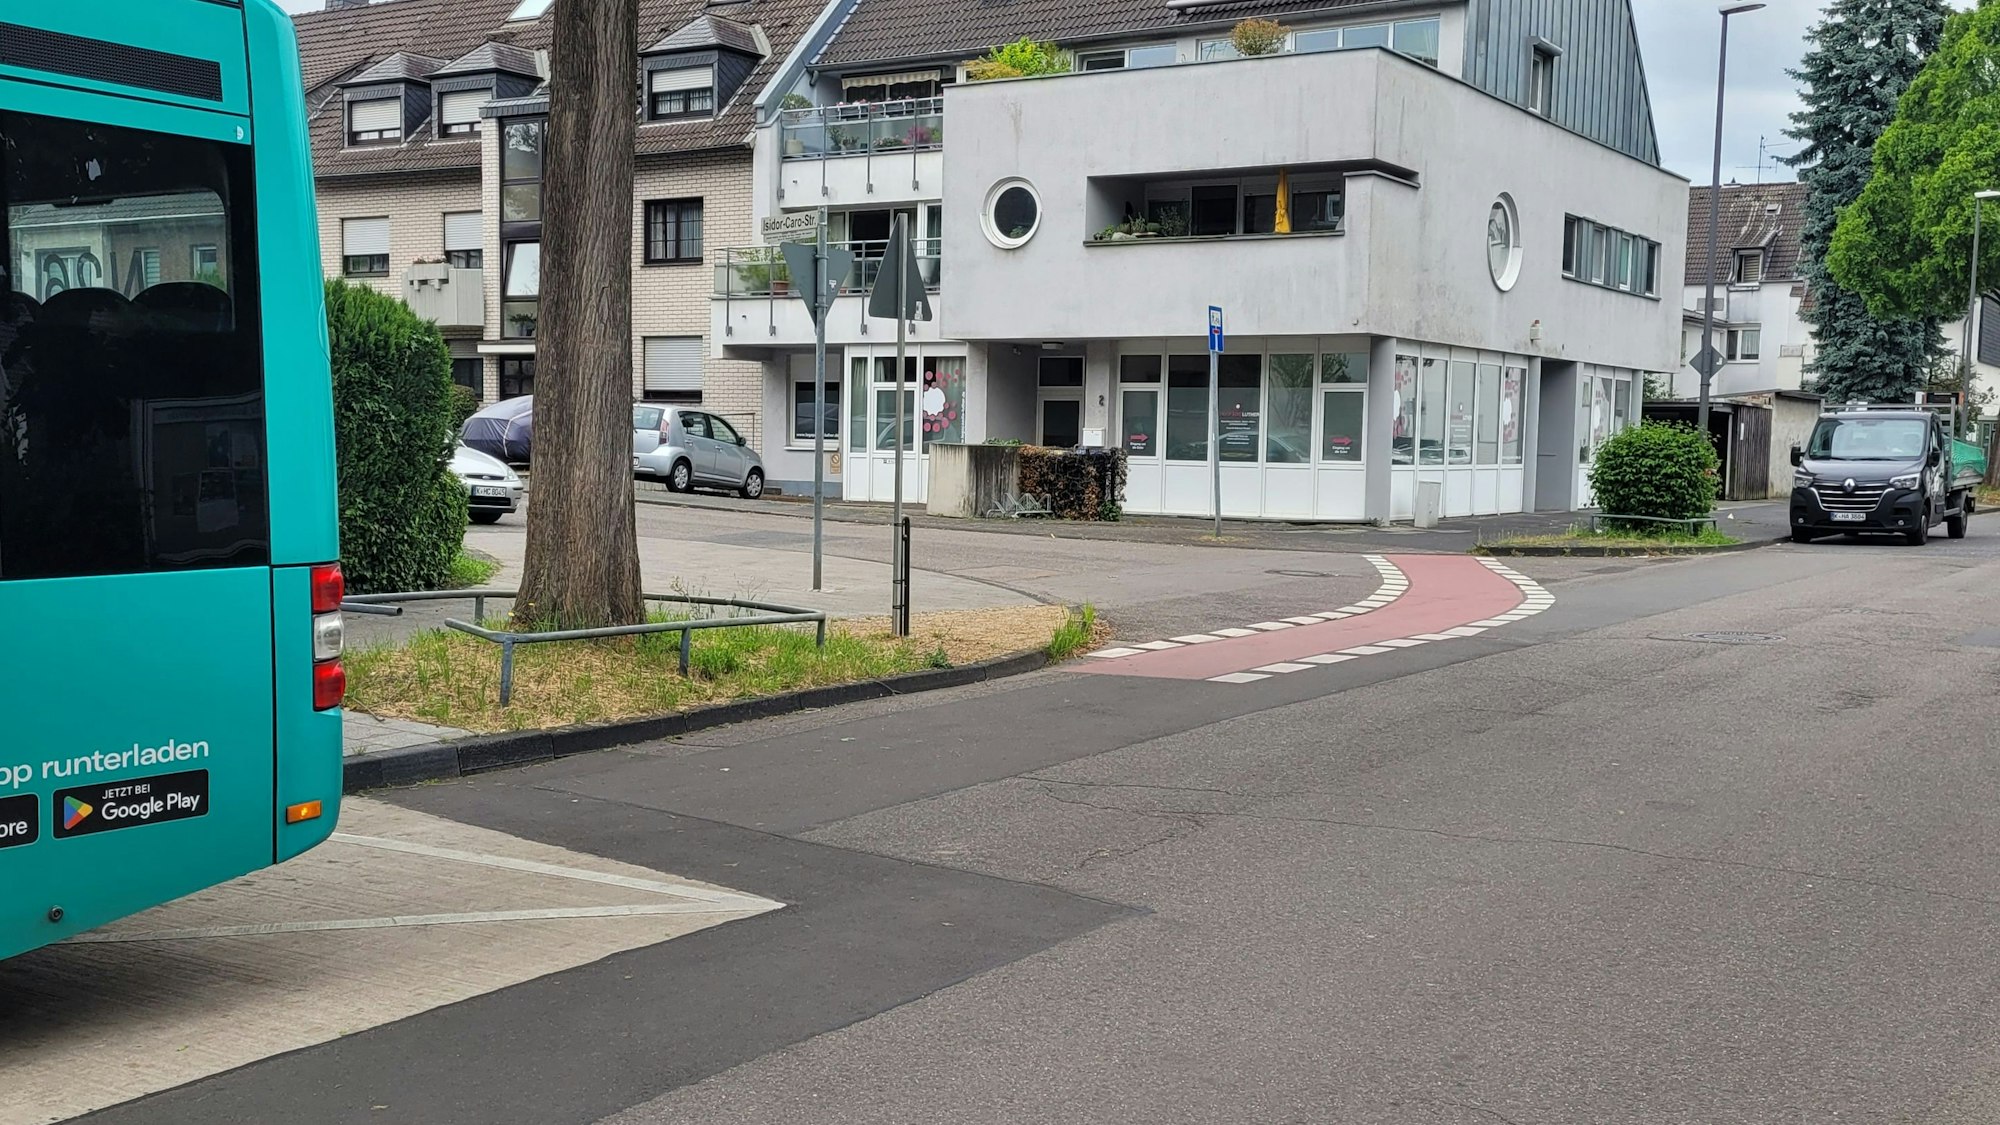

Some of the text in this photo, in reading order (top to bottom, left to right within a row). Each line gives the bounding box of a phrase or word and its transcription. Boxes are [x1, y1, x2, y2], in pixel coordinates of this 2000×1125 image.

[763, 214, 816, 231] Isidor-Caro-Str.
[42, 739, 209, 779] runterladen
[102, 784, 150, 799] JETZT BEI
[101, 792, 200, 820] Google Play
